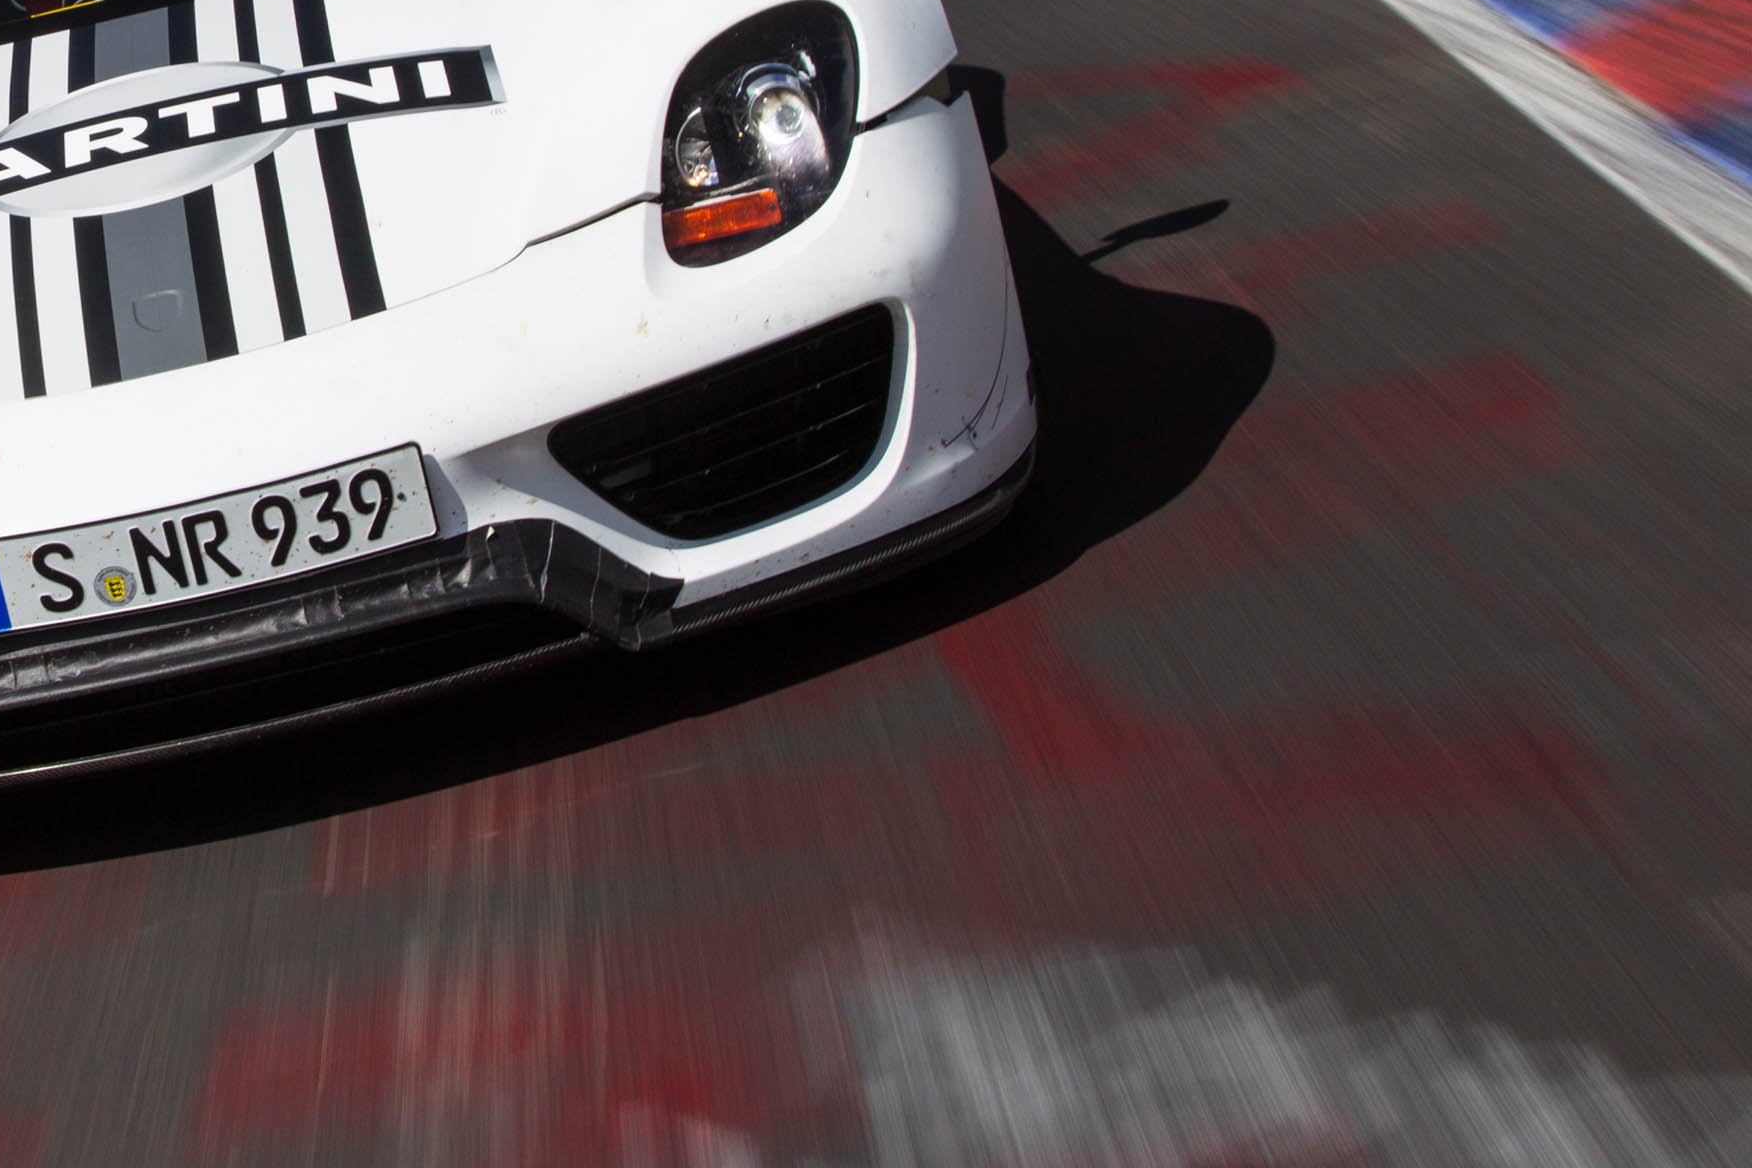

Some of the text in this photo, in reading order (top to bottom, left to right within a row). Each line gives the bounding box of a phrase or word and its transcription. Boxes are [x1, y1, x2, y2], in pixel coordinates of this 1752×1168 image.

[31, 542, 85, 612] S
[129, 509, 242, 595] NR
[250, 468, 393, 567] 939
